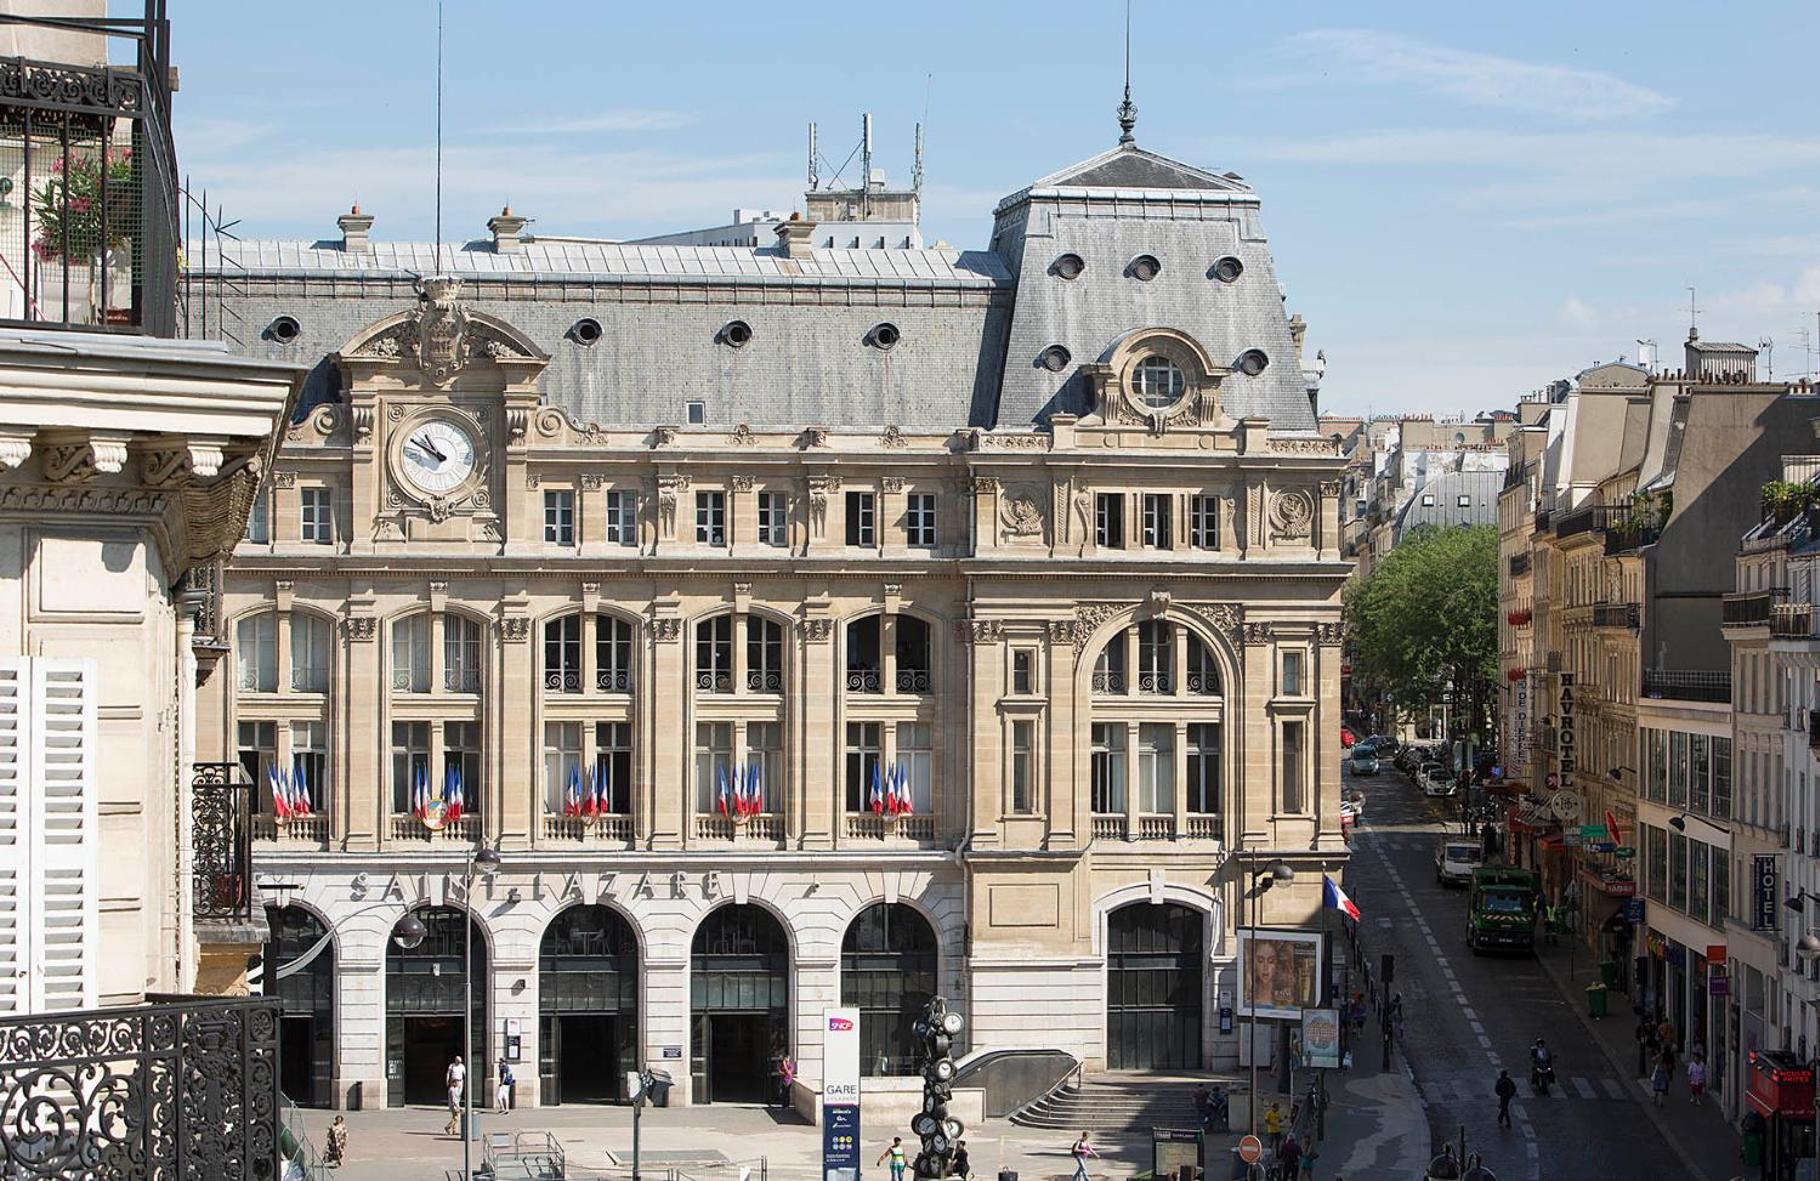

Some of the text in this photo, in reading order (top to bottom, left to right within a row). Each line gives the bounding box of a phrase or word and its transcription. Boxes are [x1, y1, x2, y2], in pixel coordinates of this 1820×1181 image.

[1560, 673, 1574, 787] HAVROTEL
[352, 870, 722, 899] SAINT LAZARE
[1762, 861, 1775, 927] HOTEL
[826, 1085, 857, 1095] GARE
